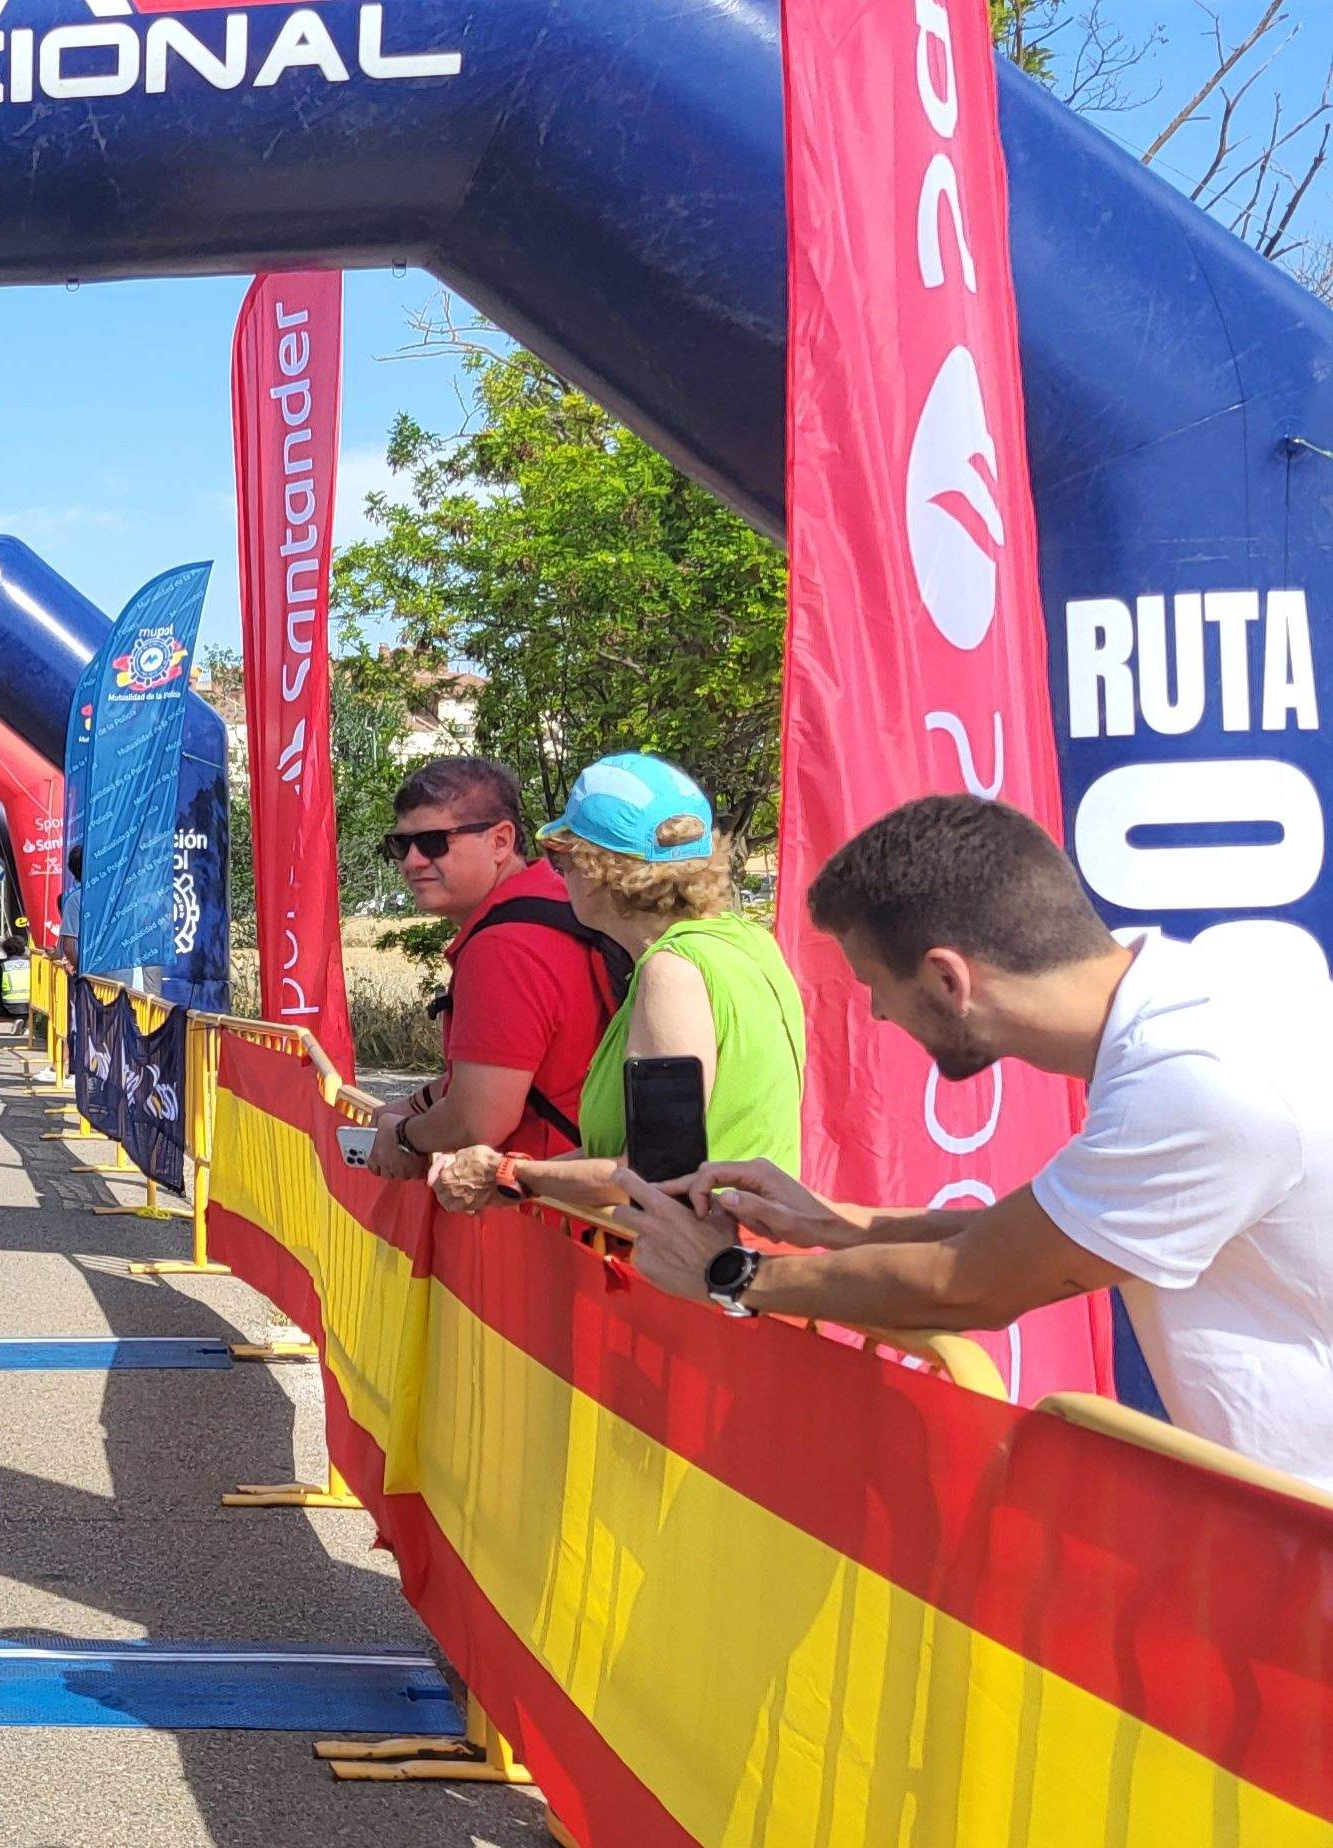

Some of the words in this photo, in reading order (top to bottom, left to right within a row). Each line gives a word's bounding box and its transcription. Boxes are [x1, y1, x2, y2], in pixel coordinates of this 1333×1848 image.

[270, 301, 319, 702] Santander
[139, 623, 174, 638] mupol
[1066, 590, 1320, 738] RUTA
[108, 692, 145, 702] Mutualidad
